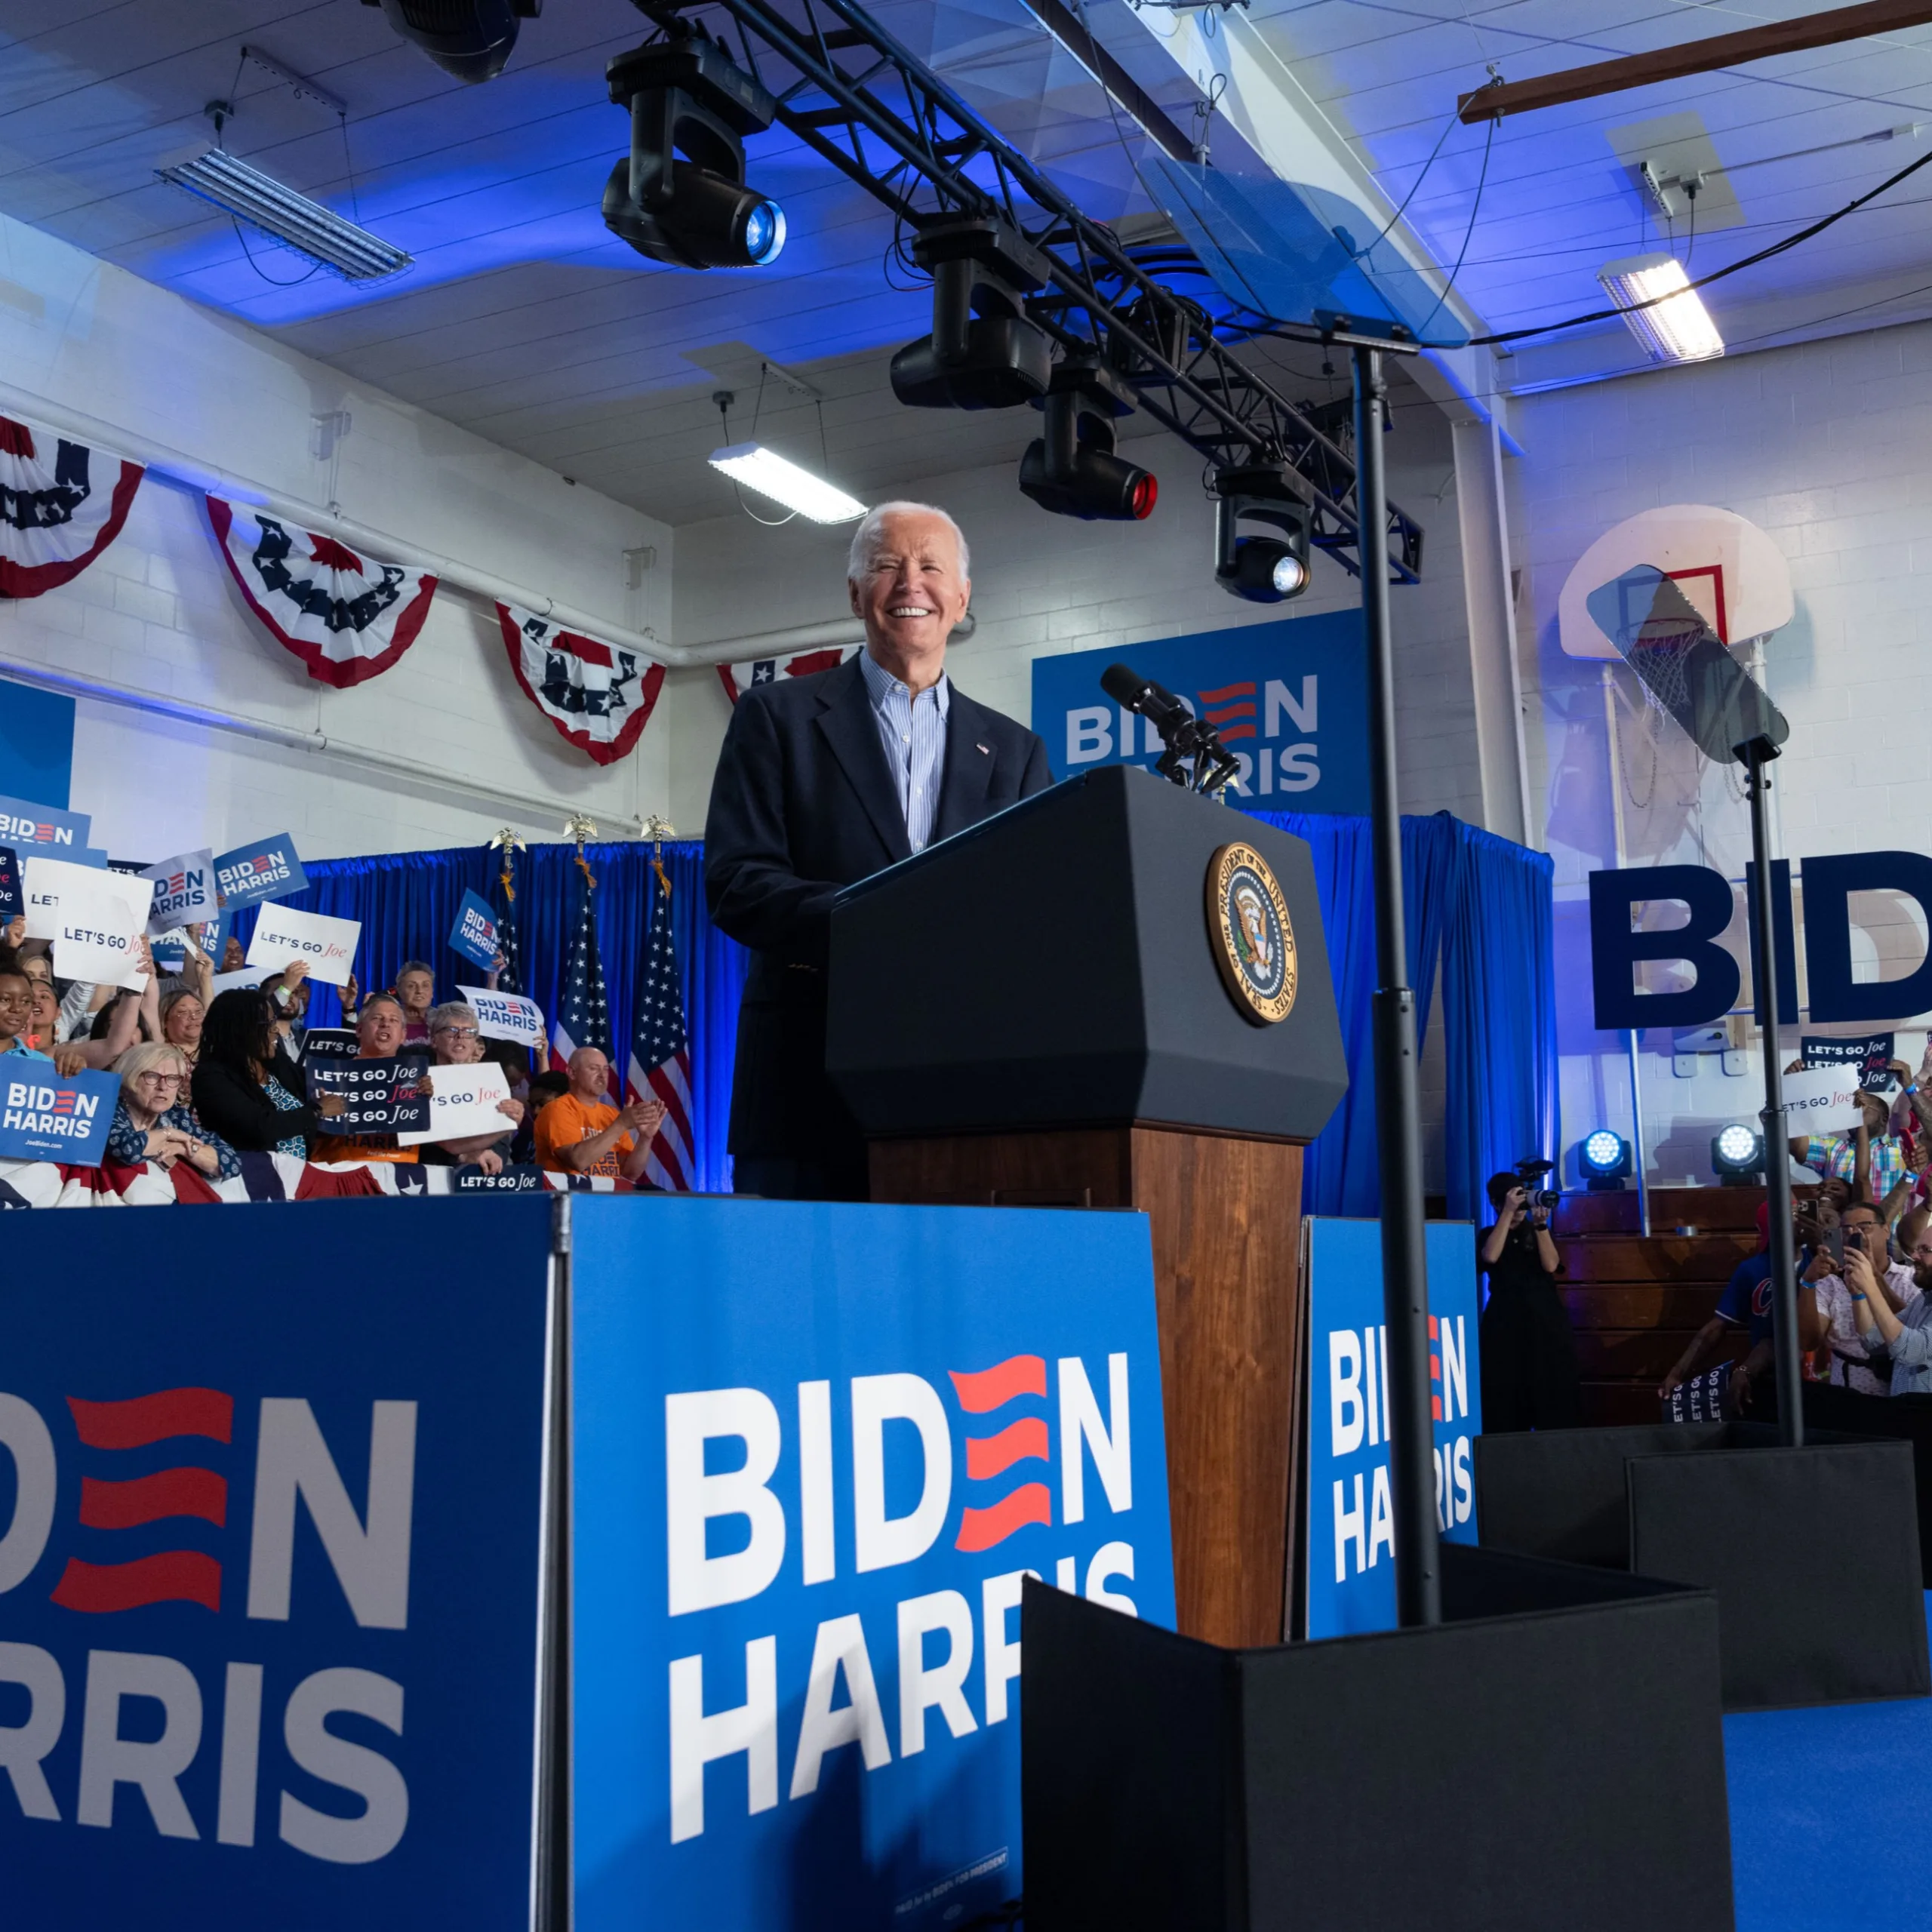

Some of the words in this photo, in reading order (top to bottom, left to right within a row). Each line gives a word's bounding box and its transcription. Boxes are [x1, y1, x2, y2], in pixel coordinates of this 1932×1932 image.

[0, 814, 73, 846] BIDEN
[217, 851, 286, 883] BIDEN
[223, 866, 291, 896] HARRIS
[1220, 848, 1245, 915] PRESIDENT
[463, 908, 500, 940] BIDEN
[1269, 880, 1293, 952] UNITED
[65, 928, 105, 946] LET'S
[107, 937, 127, 949] GO
[260, 932, 300, 949] LET'S
[302, 942, 323, 953] GO
[321, 943, 347, 958] Joe
[460, 923, 497, 955] HARRIS
[1274, 967, 1295, 1015] STATES
[475, 998, 535, 1017] BIDEN
[478, 1008, 537, 1031] HARRIS
[309, 1041, 345, 1051] LET'S
[1807, 1045, 1844, 1055] LET'S
[1845, 1046, 1864, 1055] GO
[1864, 1041, 1885, 1056] Joe
[314, 1069, 359, 1082] LET'S
[362, 1070, 387, 1081] GO
[387, 1064, 418, 1083] Joe
[1863, 1057, 1886, 1072] Joe
[1863, 1072, 1886, 1087] Joe
[7, 1082, 100, 1118] BIDEN
[362, 1091, 387, 1101] GO
[387, 1084, 417, 1103] Joe
[451, 1093, 474, 1104] GO
[475, 1088, 501, 1106] Joe
[1810, 1097, 1829, 1108] GO
[1829, 1091, 1852, 1108] Joe
[2, 1109, 92, 1139] HARRIS
[362, 1111, 387, 1122] GO
[388, 1106, 419, 1124] Joe
[25, 1140, 63, 1149] JoeBiden.com
[460, 1177, 495, 1187] LET'S
[498, 1177, 516, 1188] GO
[515, 1173, 537, 1191] Joe
[1329, 1315, 1468, 1457] BIN
[1709, 1371, 1720, 1386] GO
[1672, 1392, 1684, 1423] ET'S
[1690, 1390, 1703, 1423] ET'S
[665, 1352, 1133, 1617] BIDEN
[1333, 1435, 1472, 1583] HAIS
